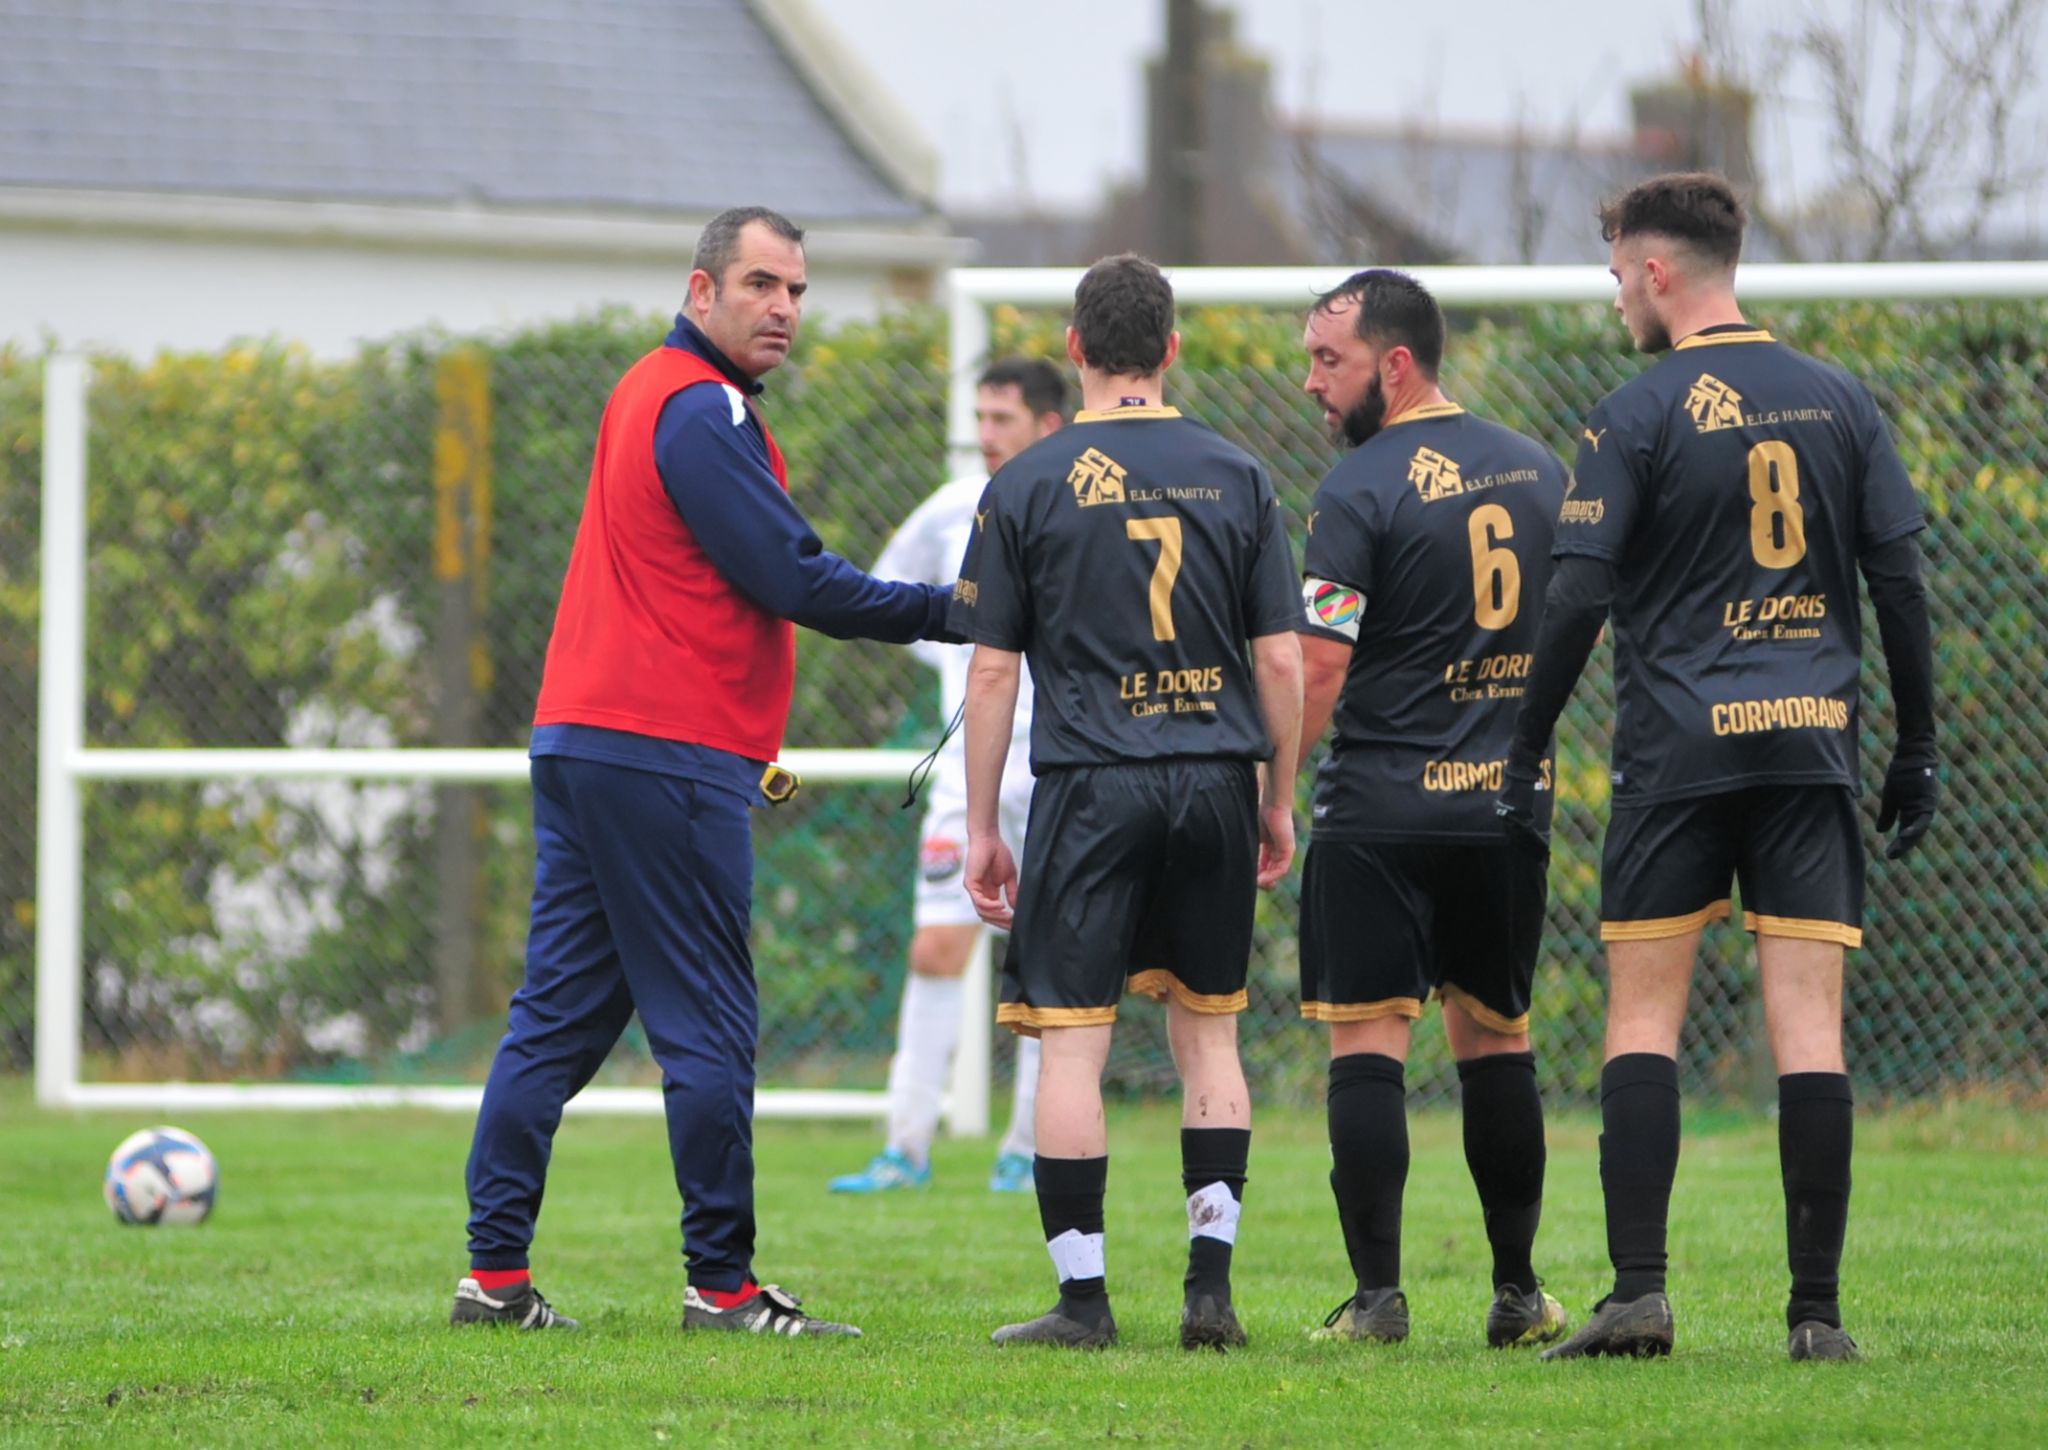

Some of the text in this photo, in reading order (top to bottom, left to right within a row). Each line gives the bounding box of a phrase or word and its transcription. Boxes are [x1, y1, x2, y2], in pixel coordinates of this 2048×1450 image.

[1781, 408, 1832, 422] HABITAT
[1495, 469, 1539, 486] HABITAT
[1166, 487, 1222, 501] HABITAT
[1748, 440, 1807, 570] 8
[1125, 516, 1183, 642] 7
[1467, 503, 1521, 631] 6
[1722, 594, 1827, 627] LE DORIS
[1732, 624, 1822, 640] Chez Emma
[1120, 666, 1223, 699] LE DORIS
[1444, 653, 1535, 684] LE DORI
[1487, 683, 1526, 699] Emm
[1131, 698, 1217, 717] Chez Emma
[1711, 696, 1848, 736] CORMORANS
[1423, 758, 1552, 791] CORMOS
